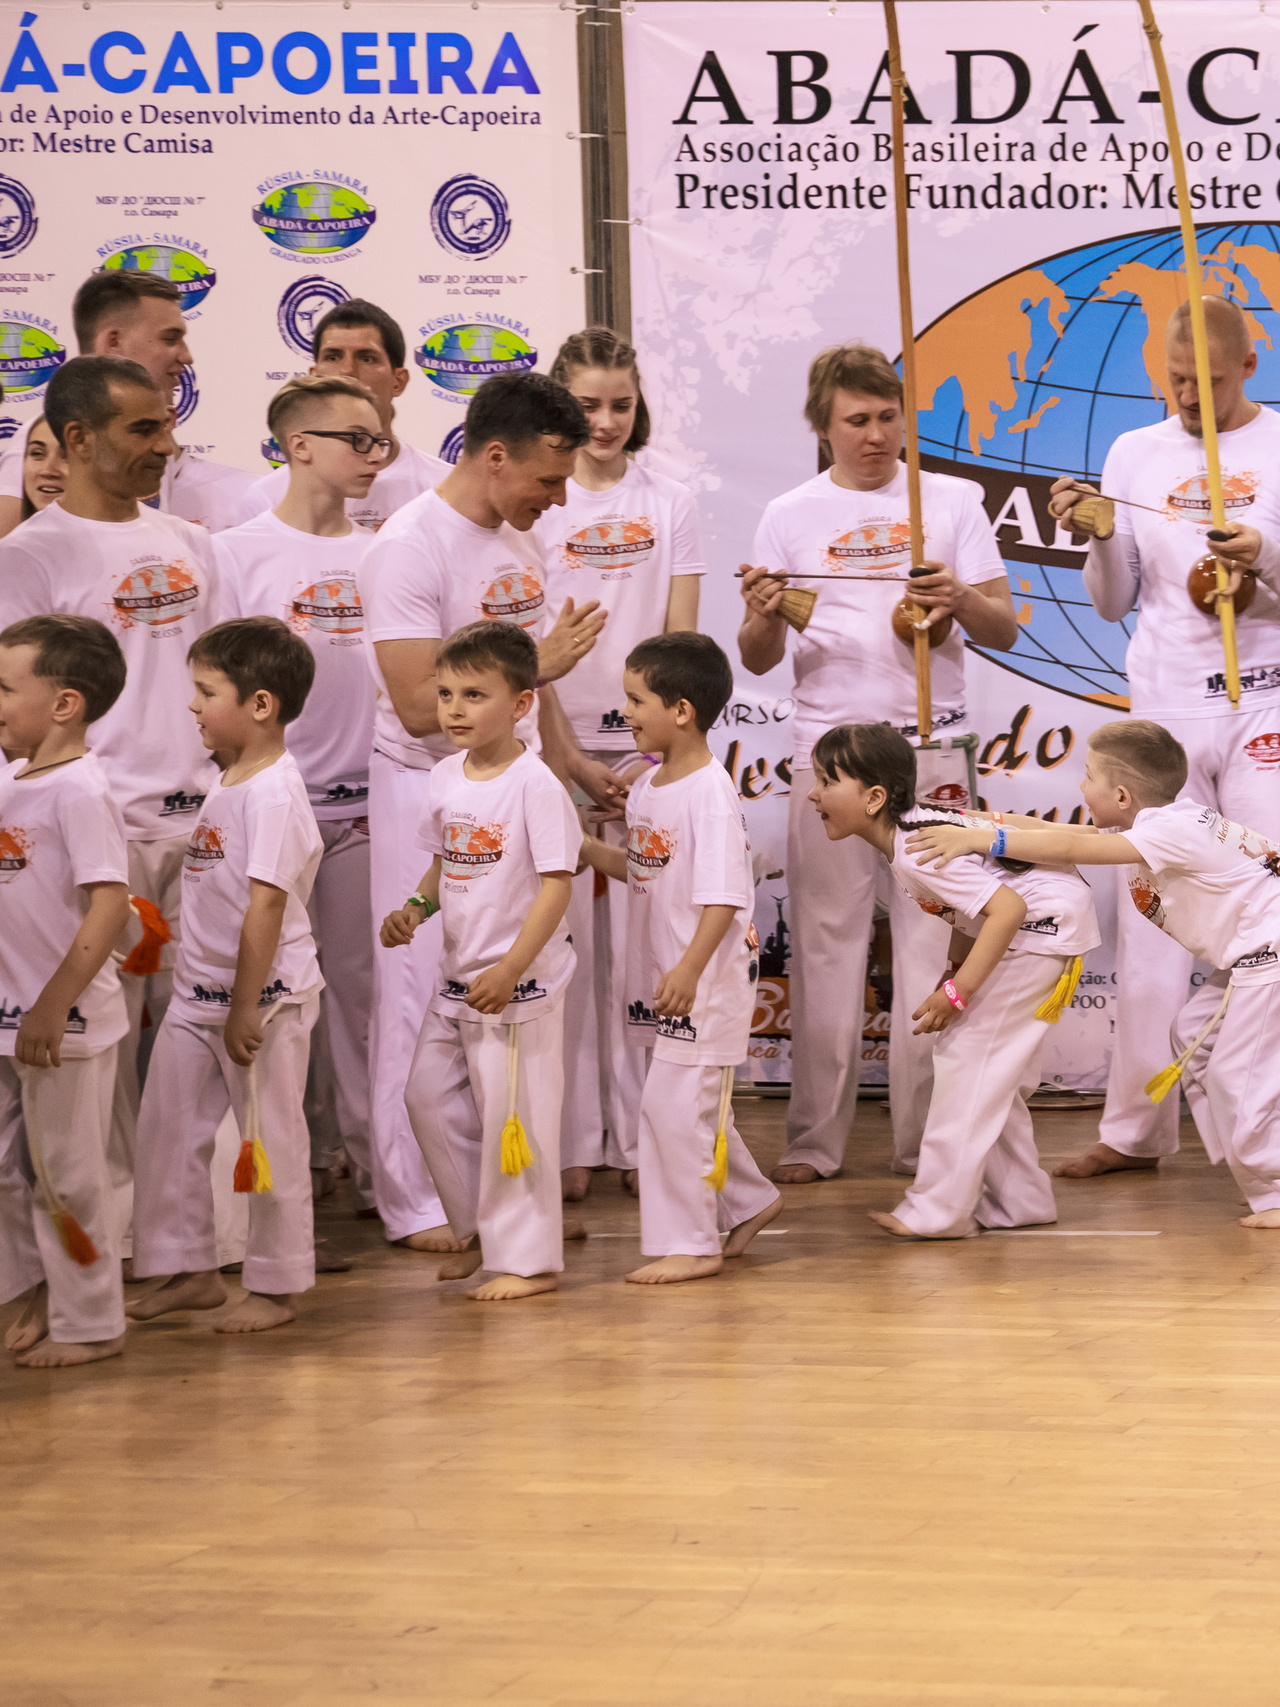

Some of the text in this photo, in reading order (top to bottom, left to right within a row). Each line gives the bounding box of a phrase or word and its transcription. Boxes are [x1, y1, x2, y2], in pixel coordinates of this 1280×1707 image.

[10, 104, 542, 132] de Apoio e Desenvolvimento da Arte-Capoeira
[32, 132, 116, 153] Mestre
[124, 132, 214, 154] Camisa
[674, 133, 860, 171] Associação
[1049, 132, 1087, 163] de
[1099, 132, 1203, 172] Apoo
[1216, 141, 1232, 162] e
[675, 171, 888, 210] Presidente
[904, 170, 1108, 210] Fundador:
[1122, 173, 1262, 210] Mestre
